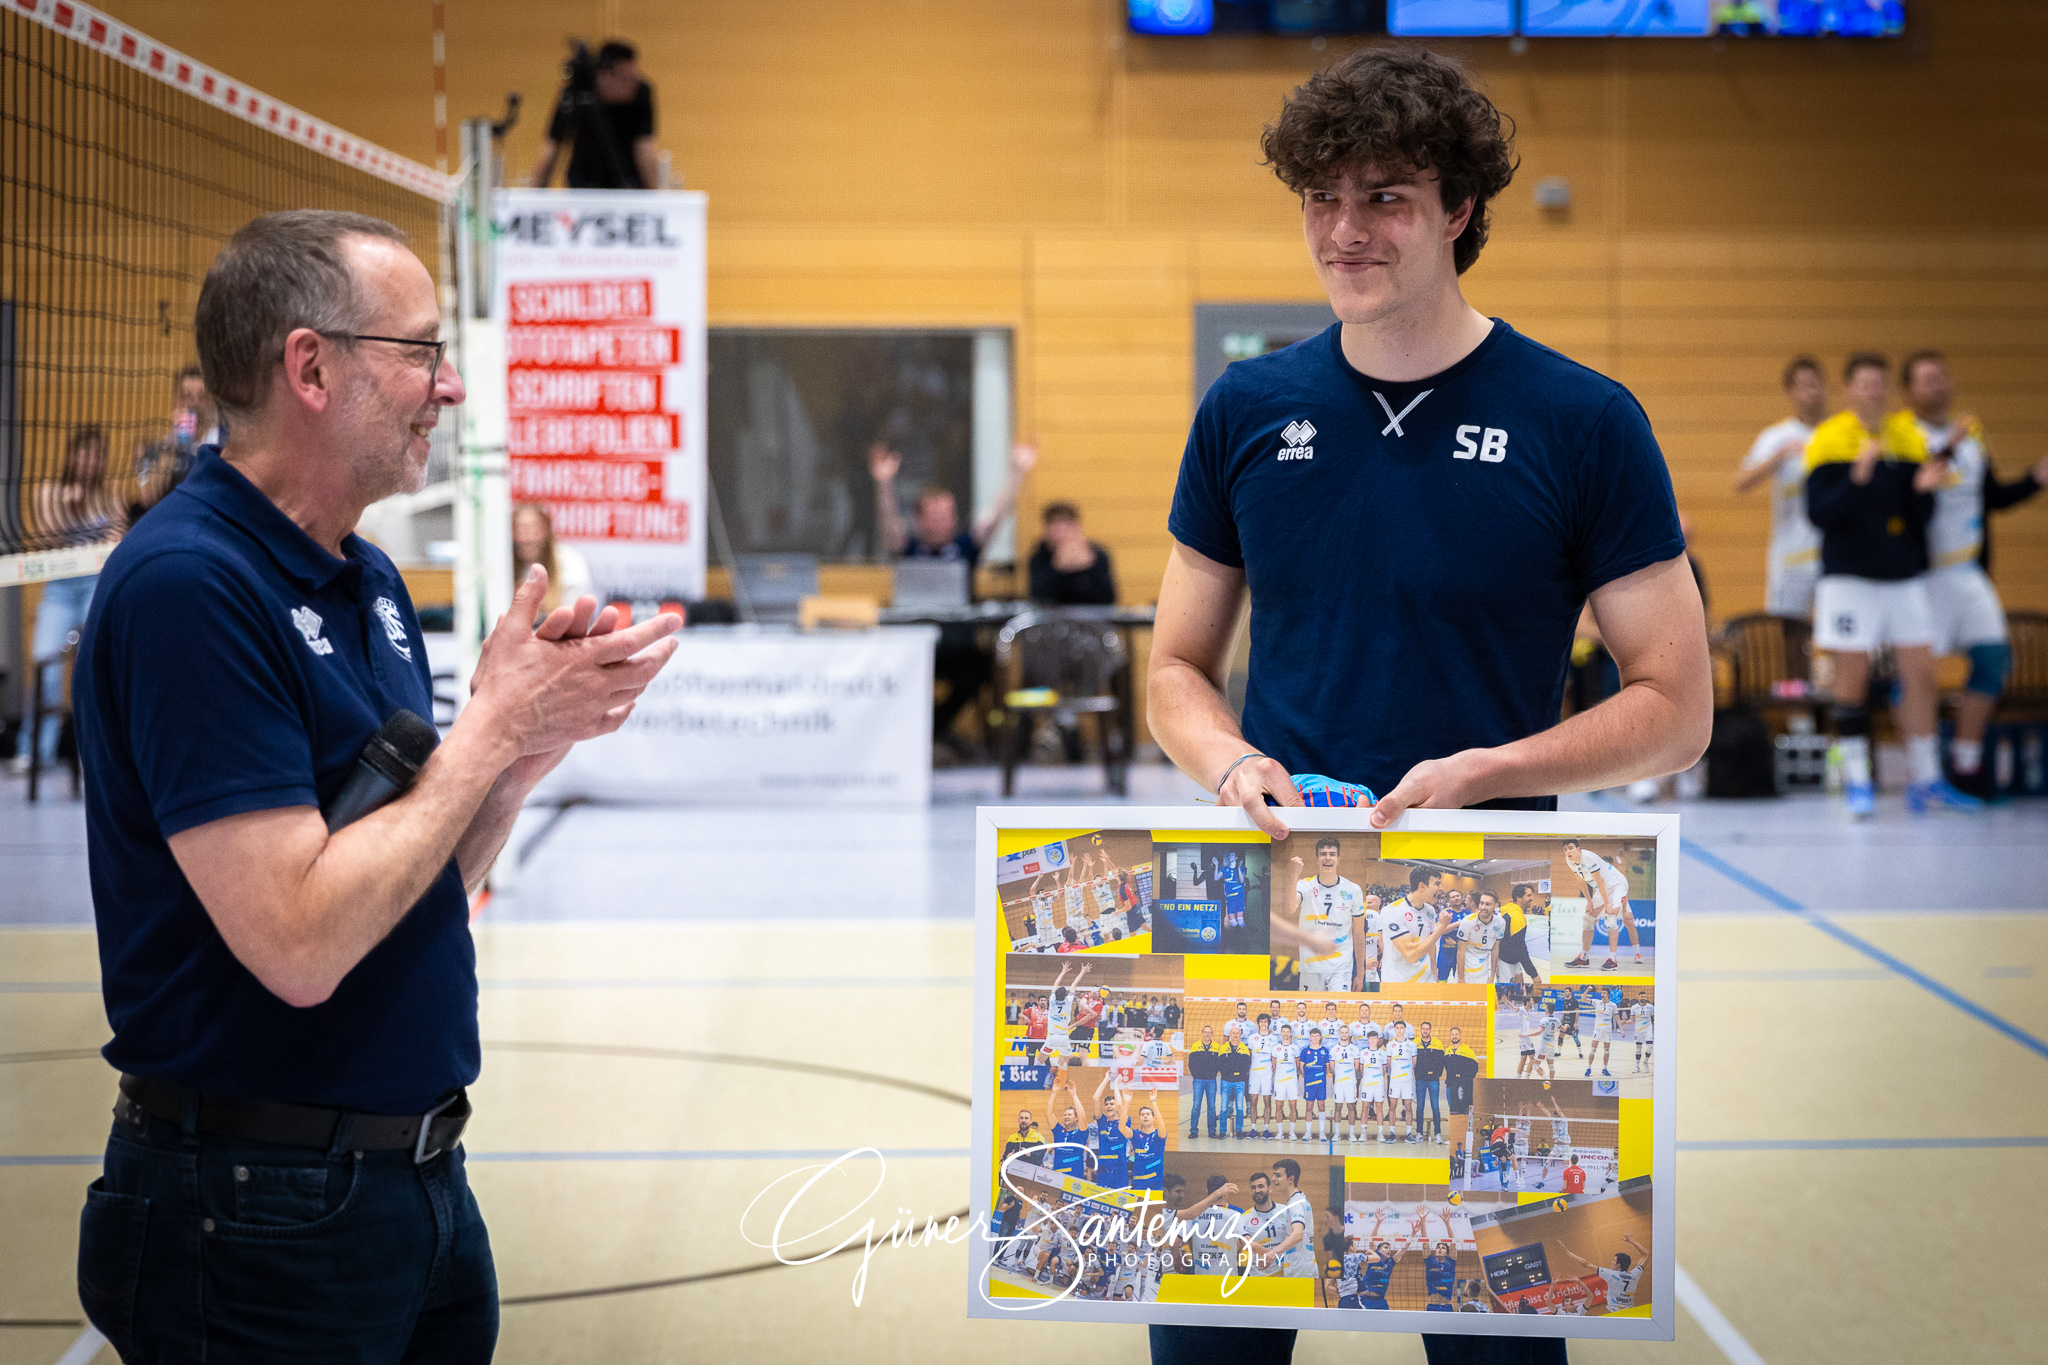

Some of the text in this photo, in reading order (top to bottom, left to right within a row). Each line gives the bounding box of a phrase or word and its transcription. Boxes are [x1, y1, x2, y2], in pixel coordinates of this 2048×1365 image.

[1453, 424, 1509, 463] SB
[1324, 903, 1333, 916] 7
[1418, 924, 1424, 936] 7
[1482, 935, 1487, 944] 6
[1009, 1065, 1038, 1082] Bier
[1574, 1175, 1580, 1184] 8
[1265, 1224, 1277, 1238] 11
[1490, 1268, 1510, 1279] HEIM
[1524, 1260, 1542, 1270] GAST
[1622, 1280, 1630, 1292] 7
